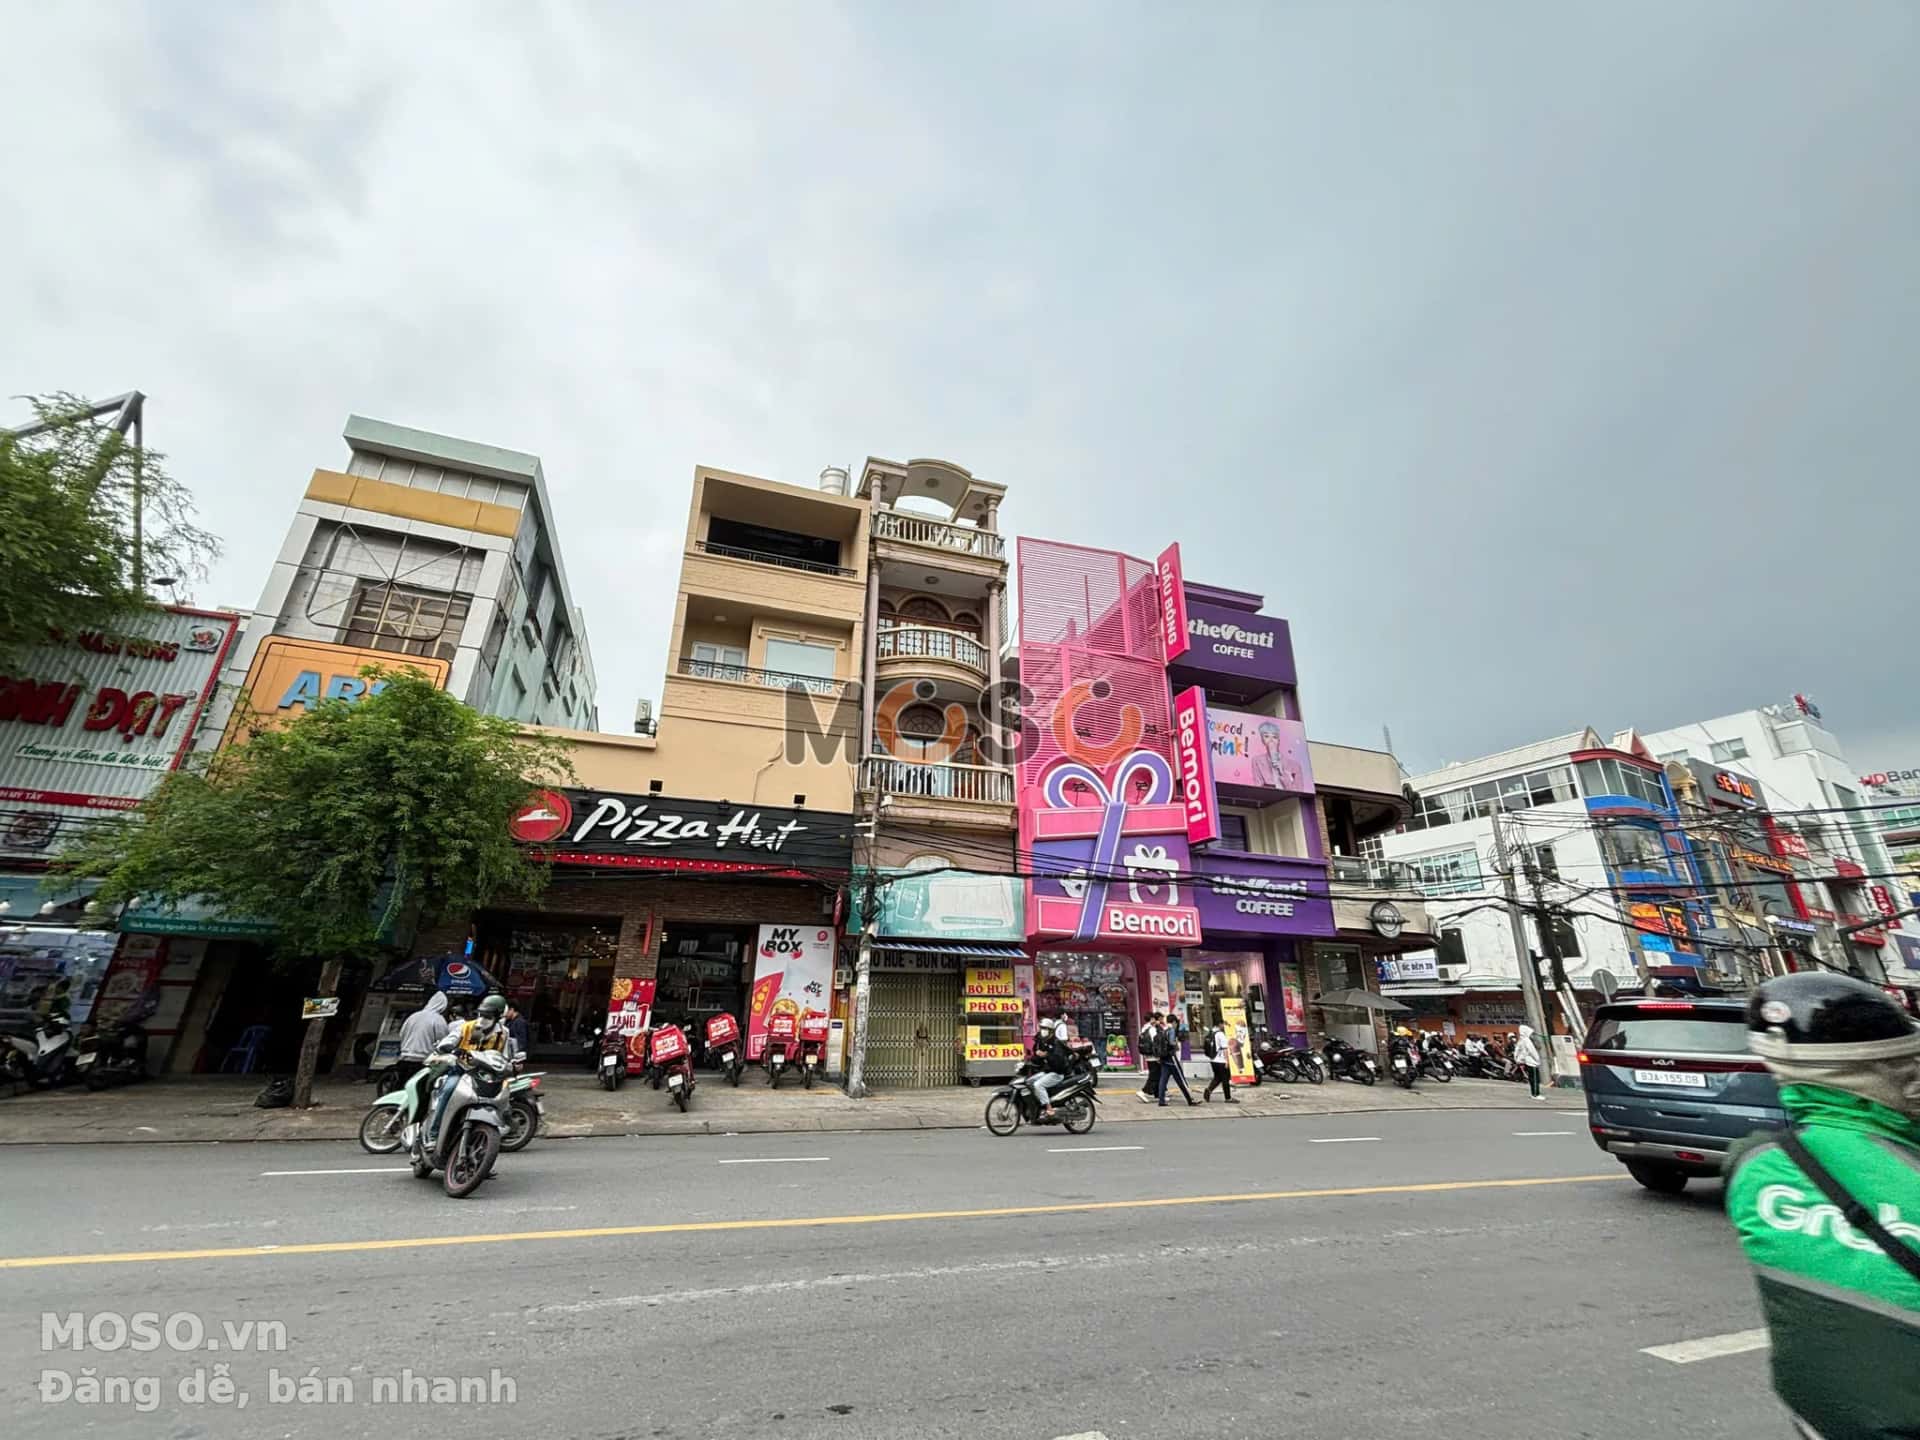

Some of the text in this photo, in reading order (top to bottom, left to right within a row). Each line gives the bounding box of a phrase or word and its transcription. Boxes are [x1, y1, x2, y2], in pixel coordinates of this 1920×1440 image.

[1164, 600, 1177, 645] BÔNG
[1213, 643, 1254, 659] COFFEE
[83, 687, 188, 743] ĐẠT
[1179, 707, 1207, 823] Bemori
[573, 798, 808, 851] Pizza Hut
[1235, 899, 1294, 916] COFFEE
[772, 927, 800, 941] MY
[1109, 909, 1194, 935] Bemori
[765, 940, 803, 954] BOX
